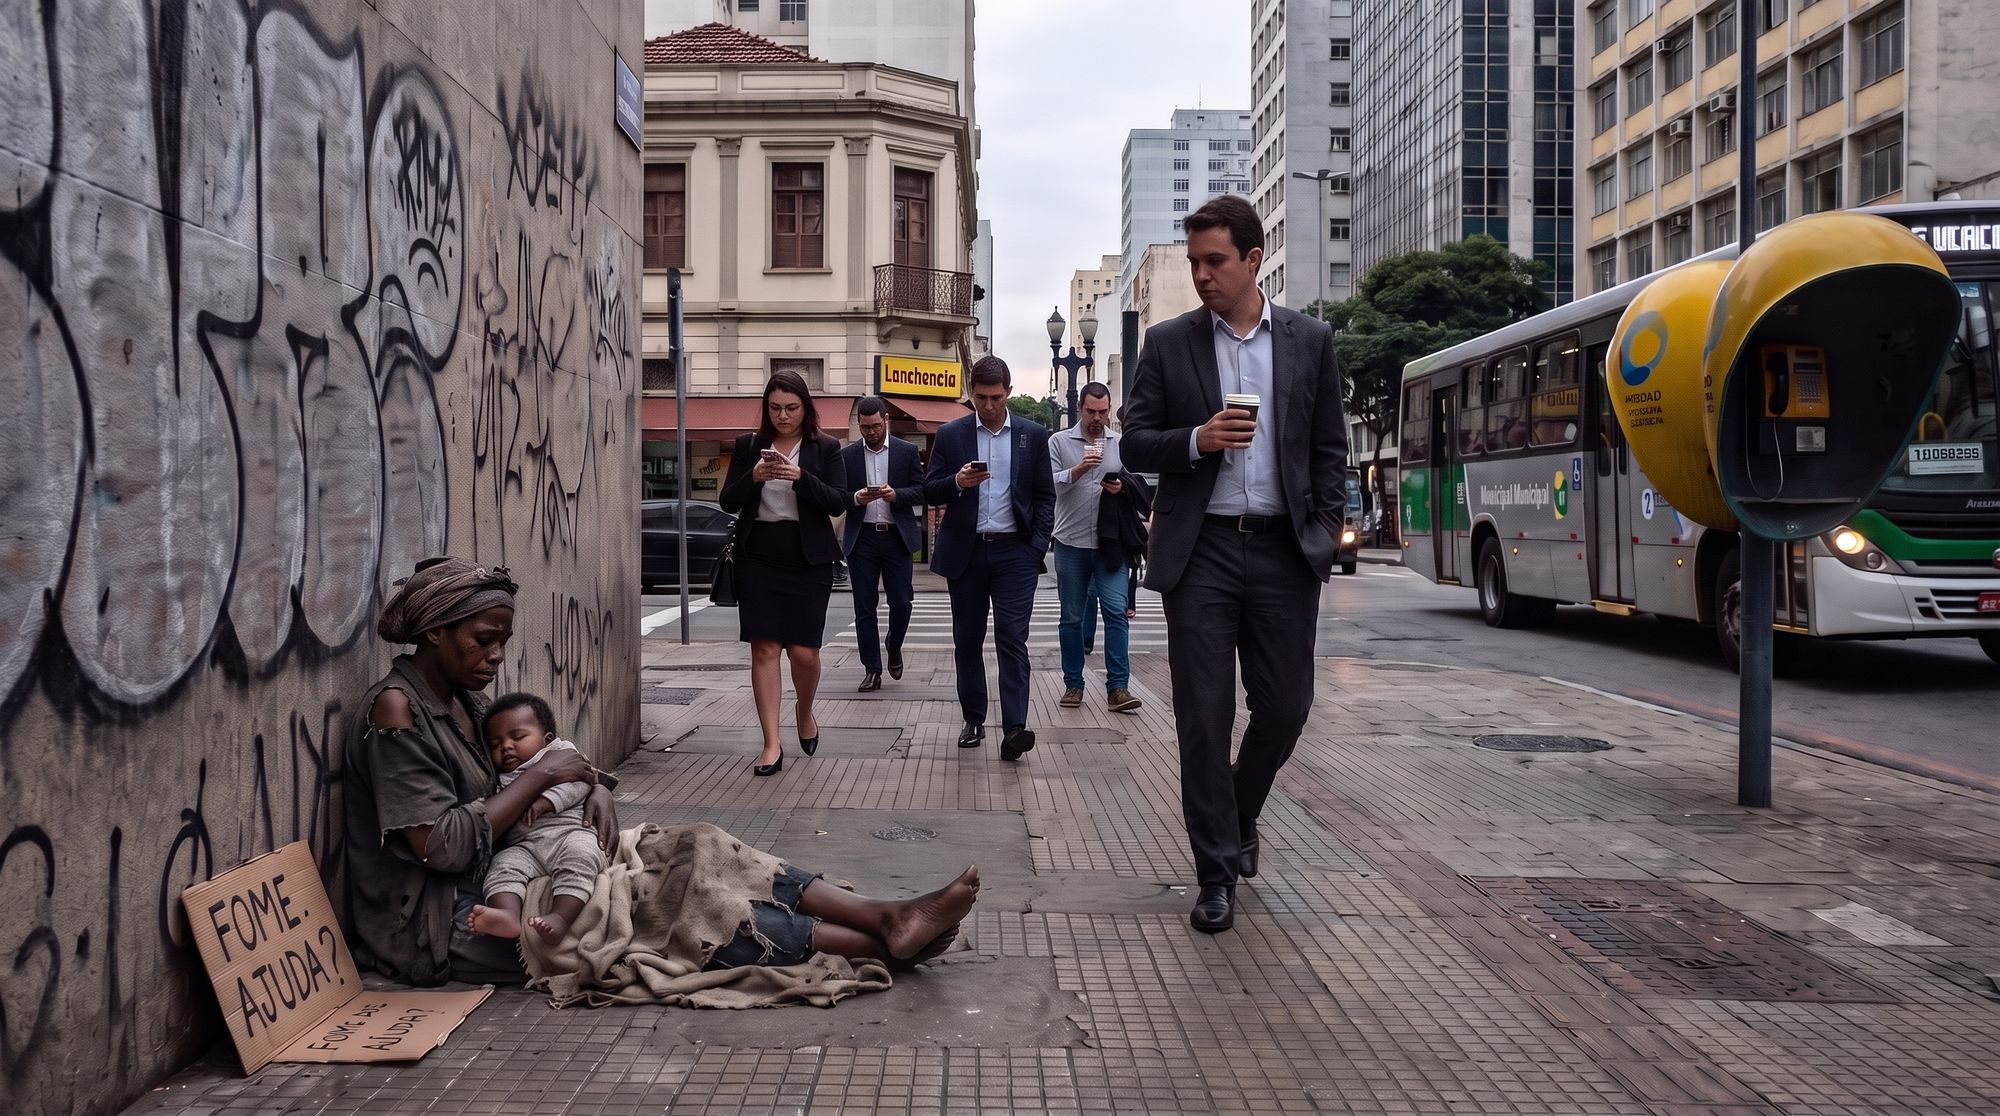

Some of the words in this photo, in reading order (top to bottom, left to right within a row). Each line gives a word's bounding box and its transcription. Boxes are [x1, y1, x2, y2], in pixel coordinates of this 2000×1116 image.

[885, 364, 956, 388] Lanchencia
[1645, 492, 1651, 514] 2
[208, 874, 310, 962] FOME.
[237, 926, 345, 1038] AJUDA?
[307, 1021, 366, 1050] FOME
